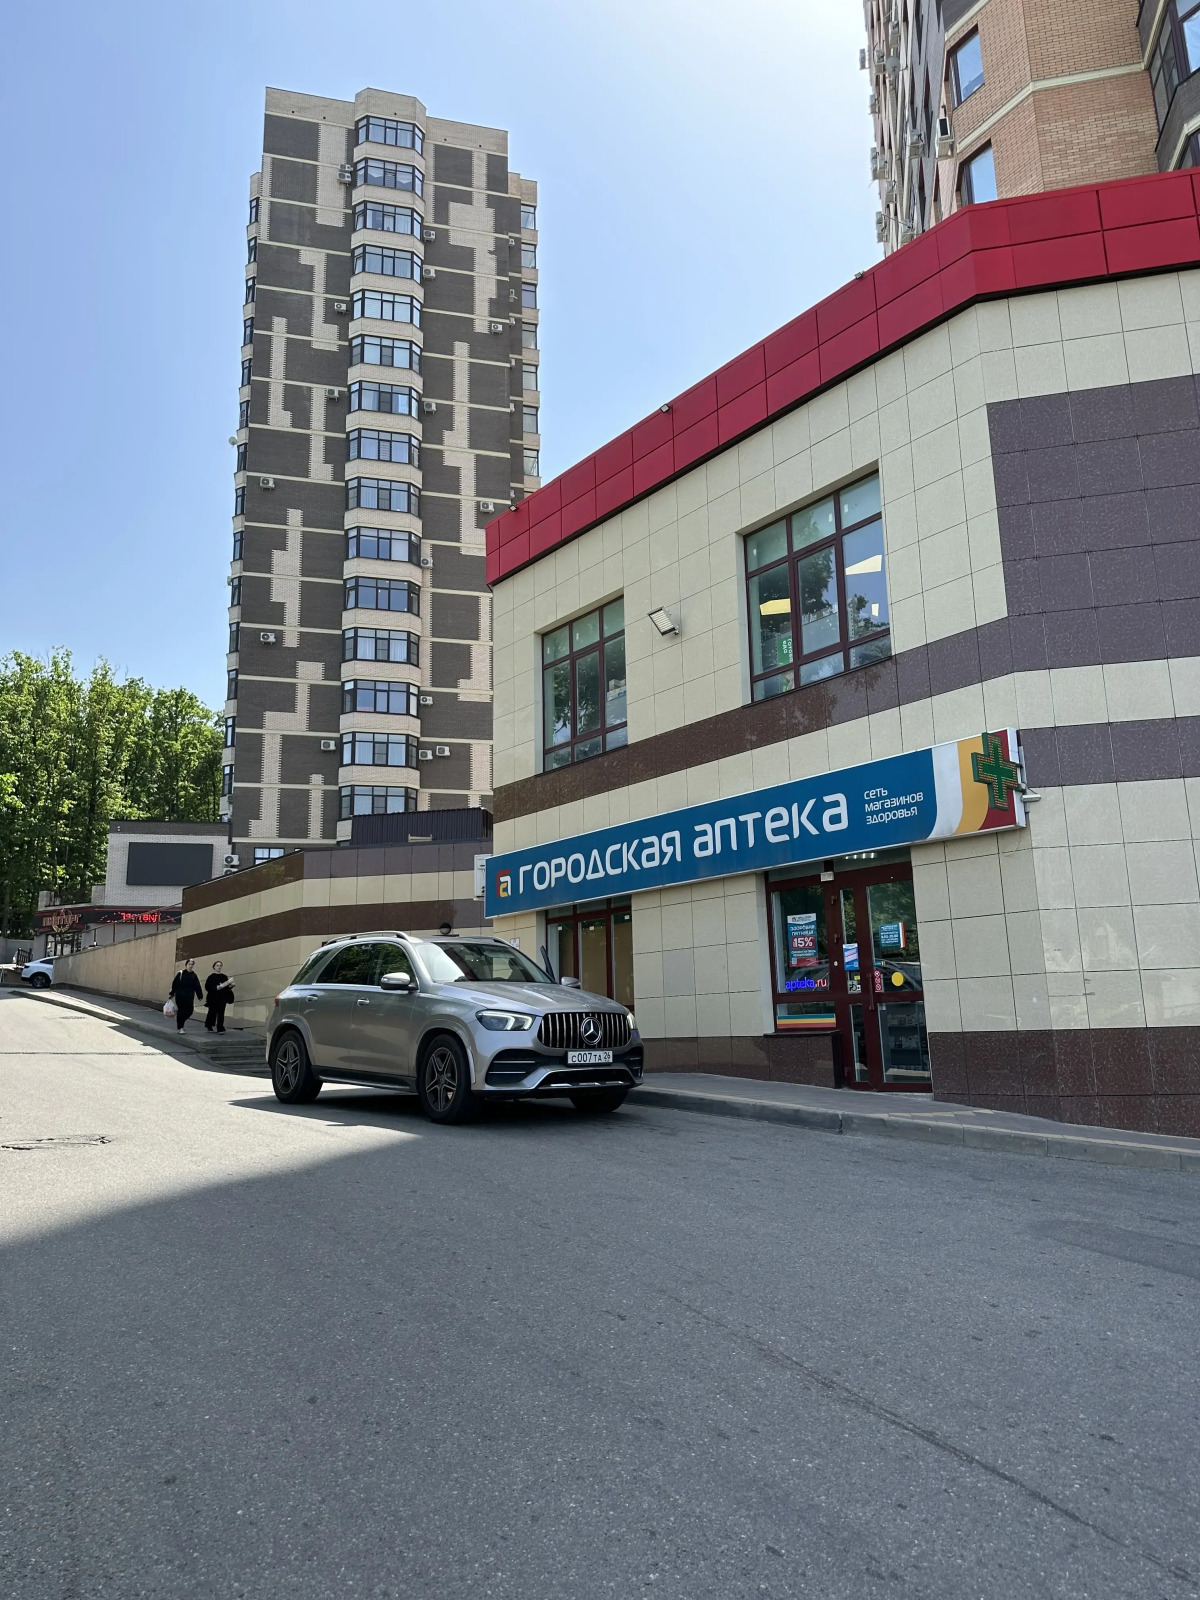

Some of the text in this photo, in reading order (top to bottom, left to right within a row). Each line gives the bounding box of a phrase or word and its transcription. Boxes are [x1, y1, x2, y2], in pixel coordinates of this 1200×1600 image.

[864, 787, 888, 800] сеть
[864, 792, 924, 812] магазинов
[866, 806, 918, 825] здоровья
[785, 976, 827, 992] apteka.ru
